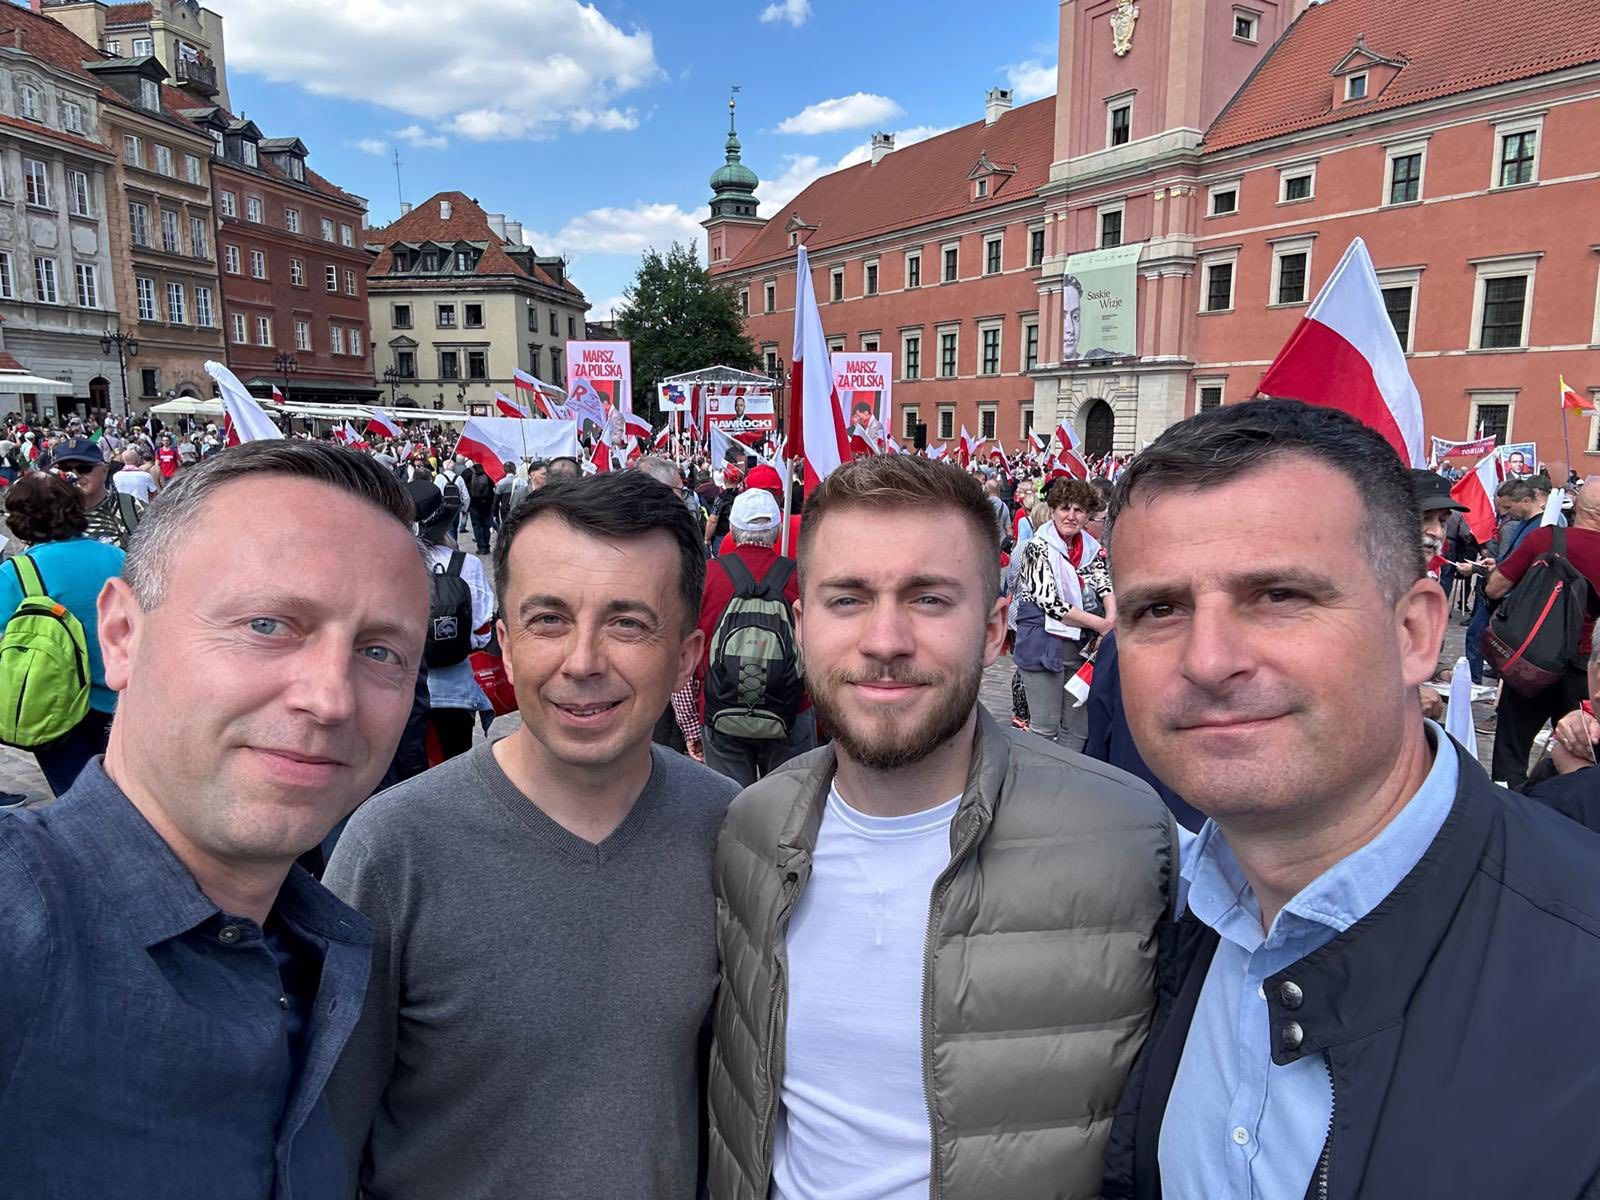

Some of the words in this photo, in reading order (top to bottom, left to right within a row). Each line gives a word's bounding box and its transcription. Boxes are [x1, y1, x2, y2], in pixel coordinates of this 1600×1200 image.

[1087, 290, 1110, 300] Saskie
[1100, 297, 1122, 309] Wizje
[582, 350, 614, 363] MARSZ
[575, 364, 587, 377] ZA
[588, 364, 623, 379] POLSKĄ
[846, 361, 877, 373] MARSZ
[838, 375, 849, 387] ZA
[851, 375, 884, 389] POLSKĄ
[709, 419, 772, 429] NAWROCKI
